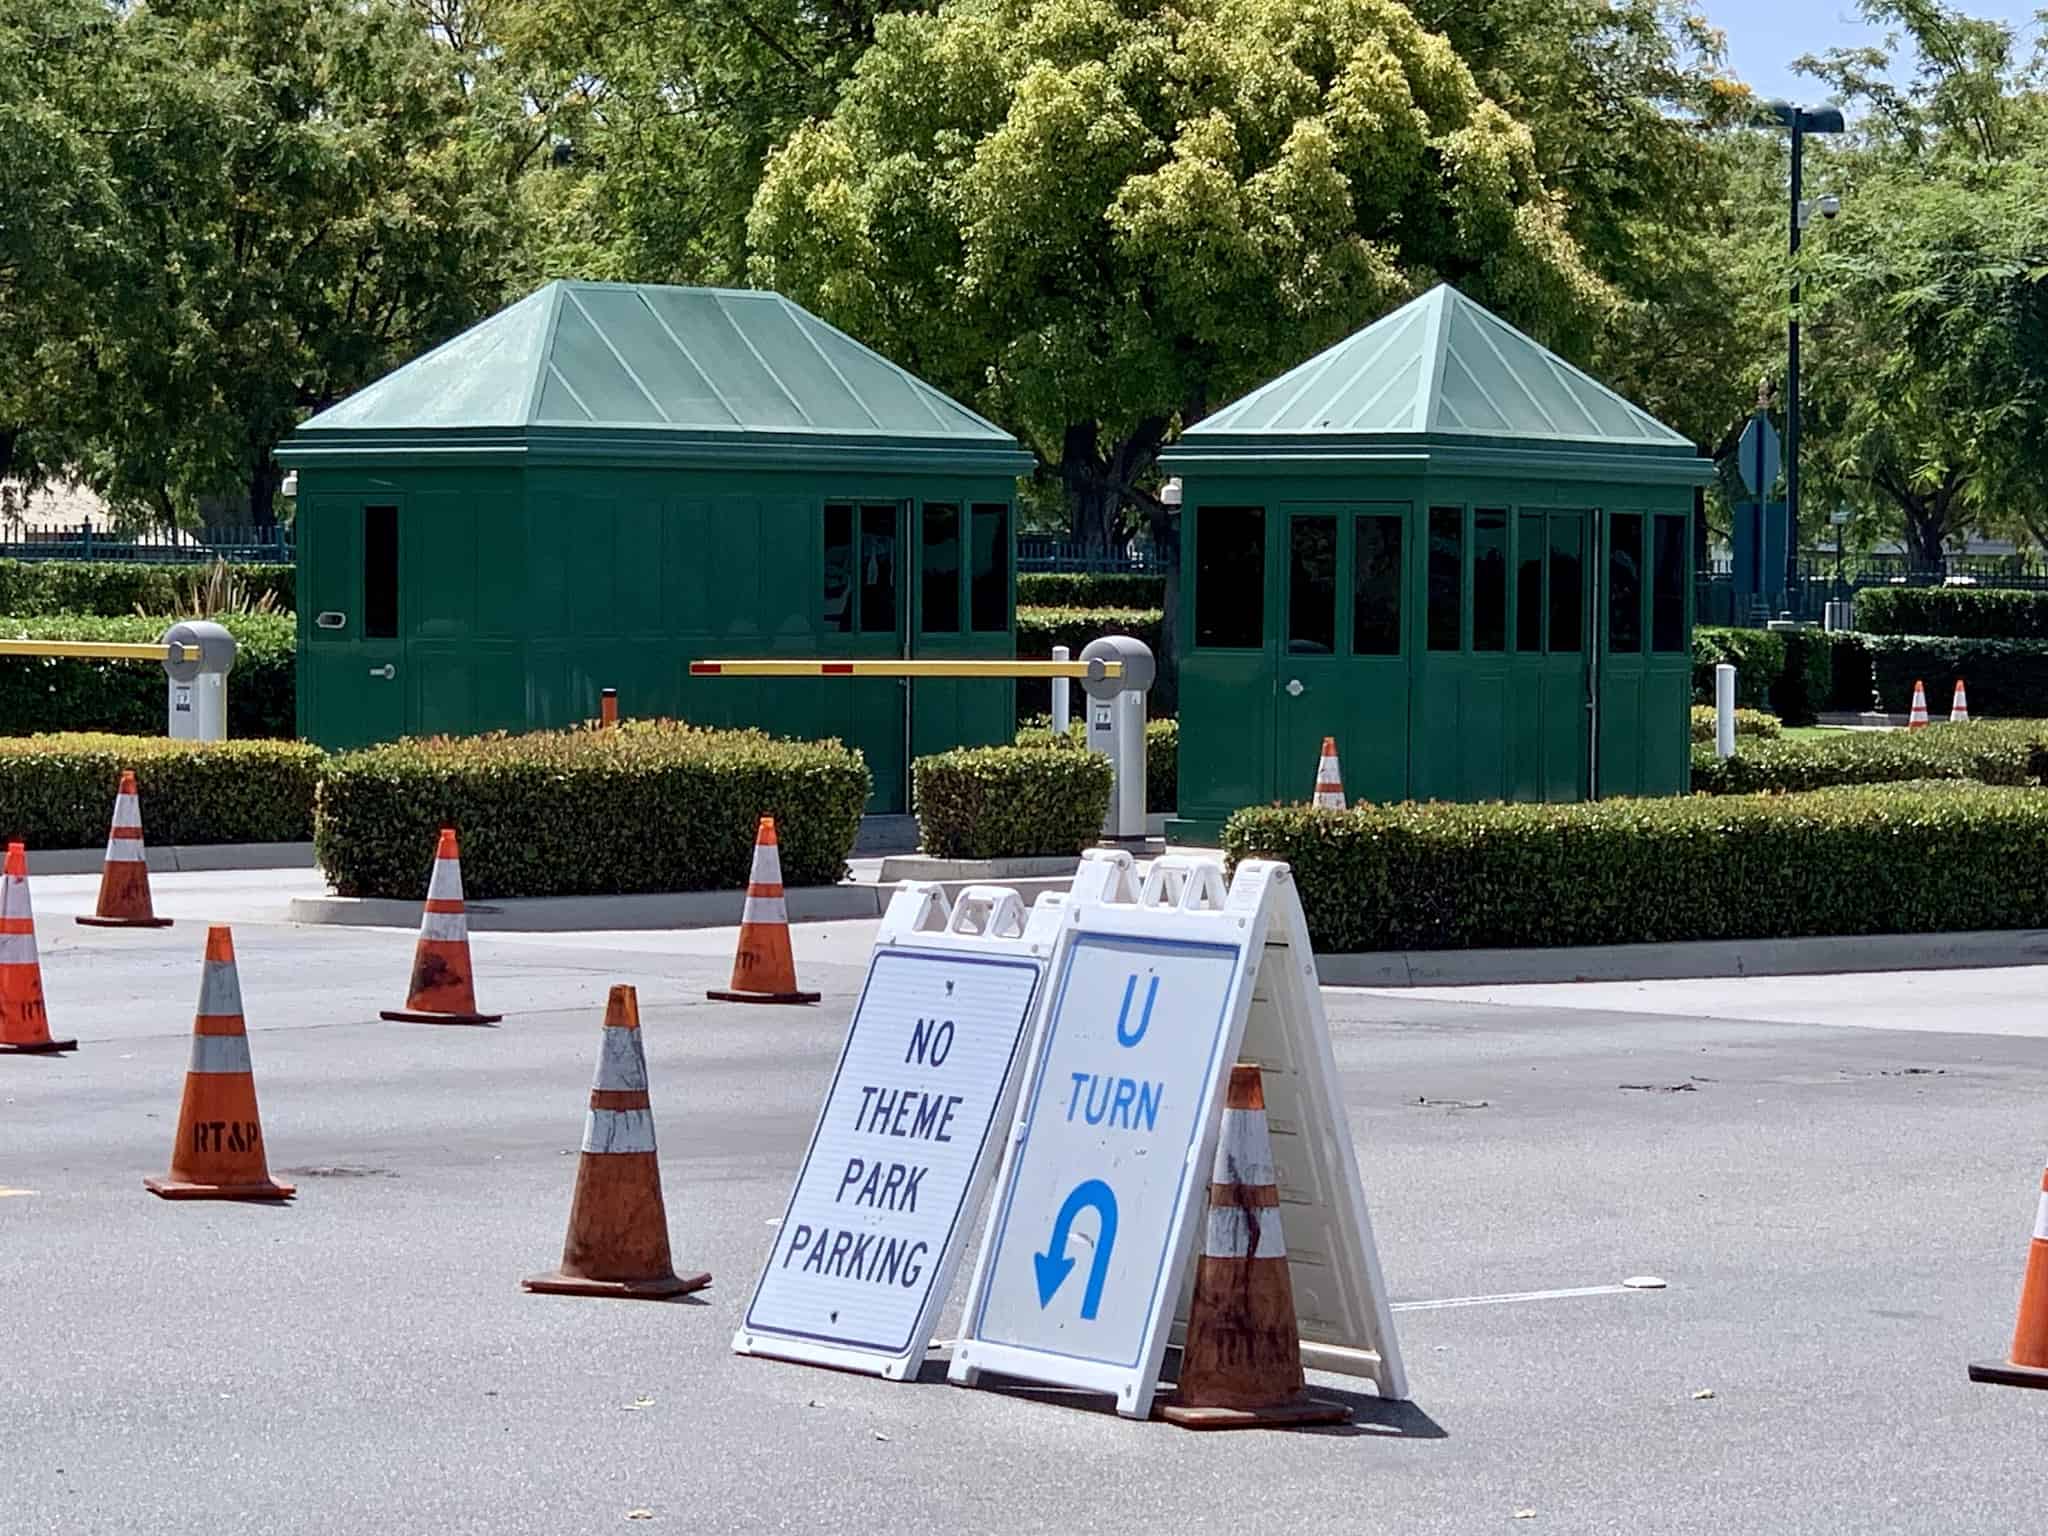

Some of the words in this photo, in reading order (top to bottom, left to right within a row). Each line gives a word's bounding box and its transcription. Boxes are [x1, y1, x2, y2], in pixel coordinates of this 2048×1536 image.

[1117, 974, 1160, 1048] U
[905, 1018, 954, 1067] NO
[854, 1086, 963, 1142] THEME
[1067, 1072, 1164, 1130] TURN
[835, 1158, 928, 1212] PARK
[783, 1225, 928, 1288] PARKING
